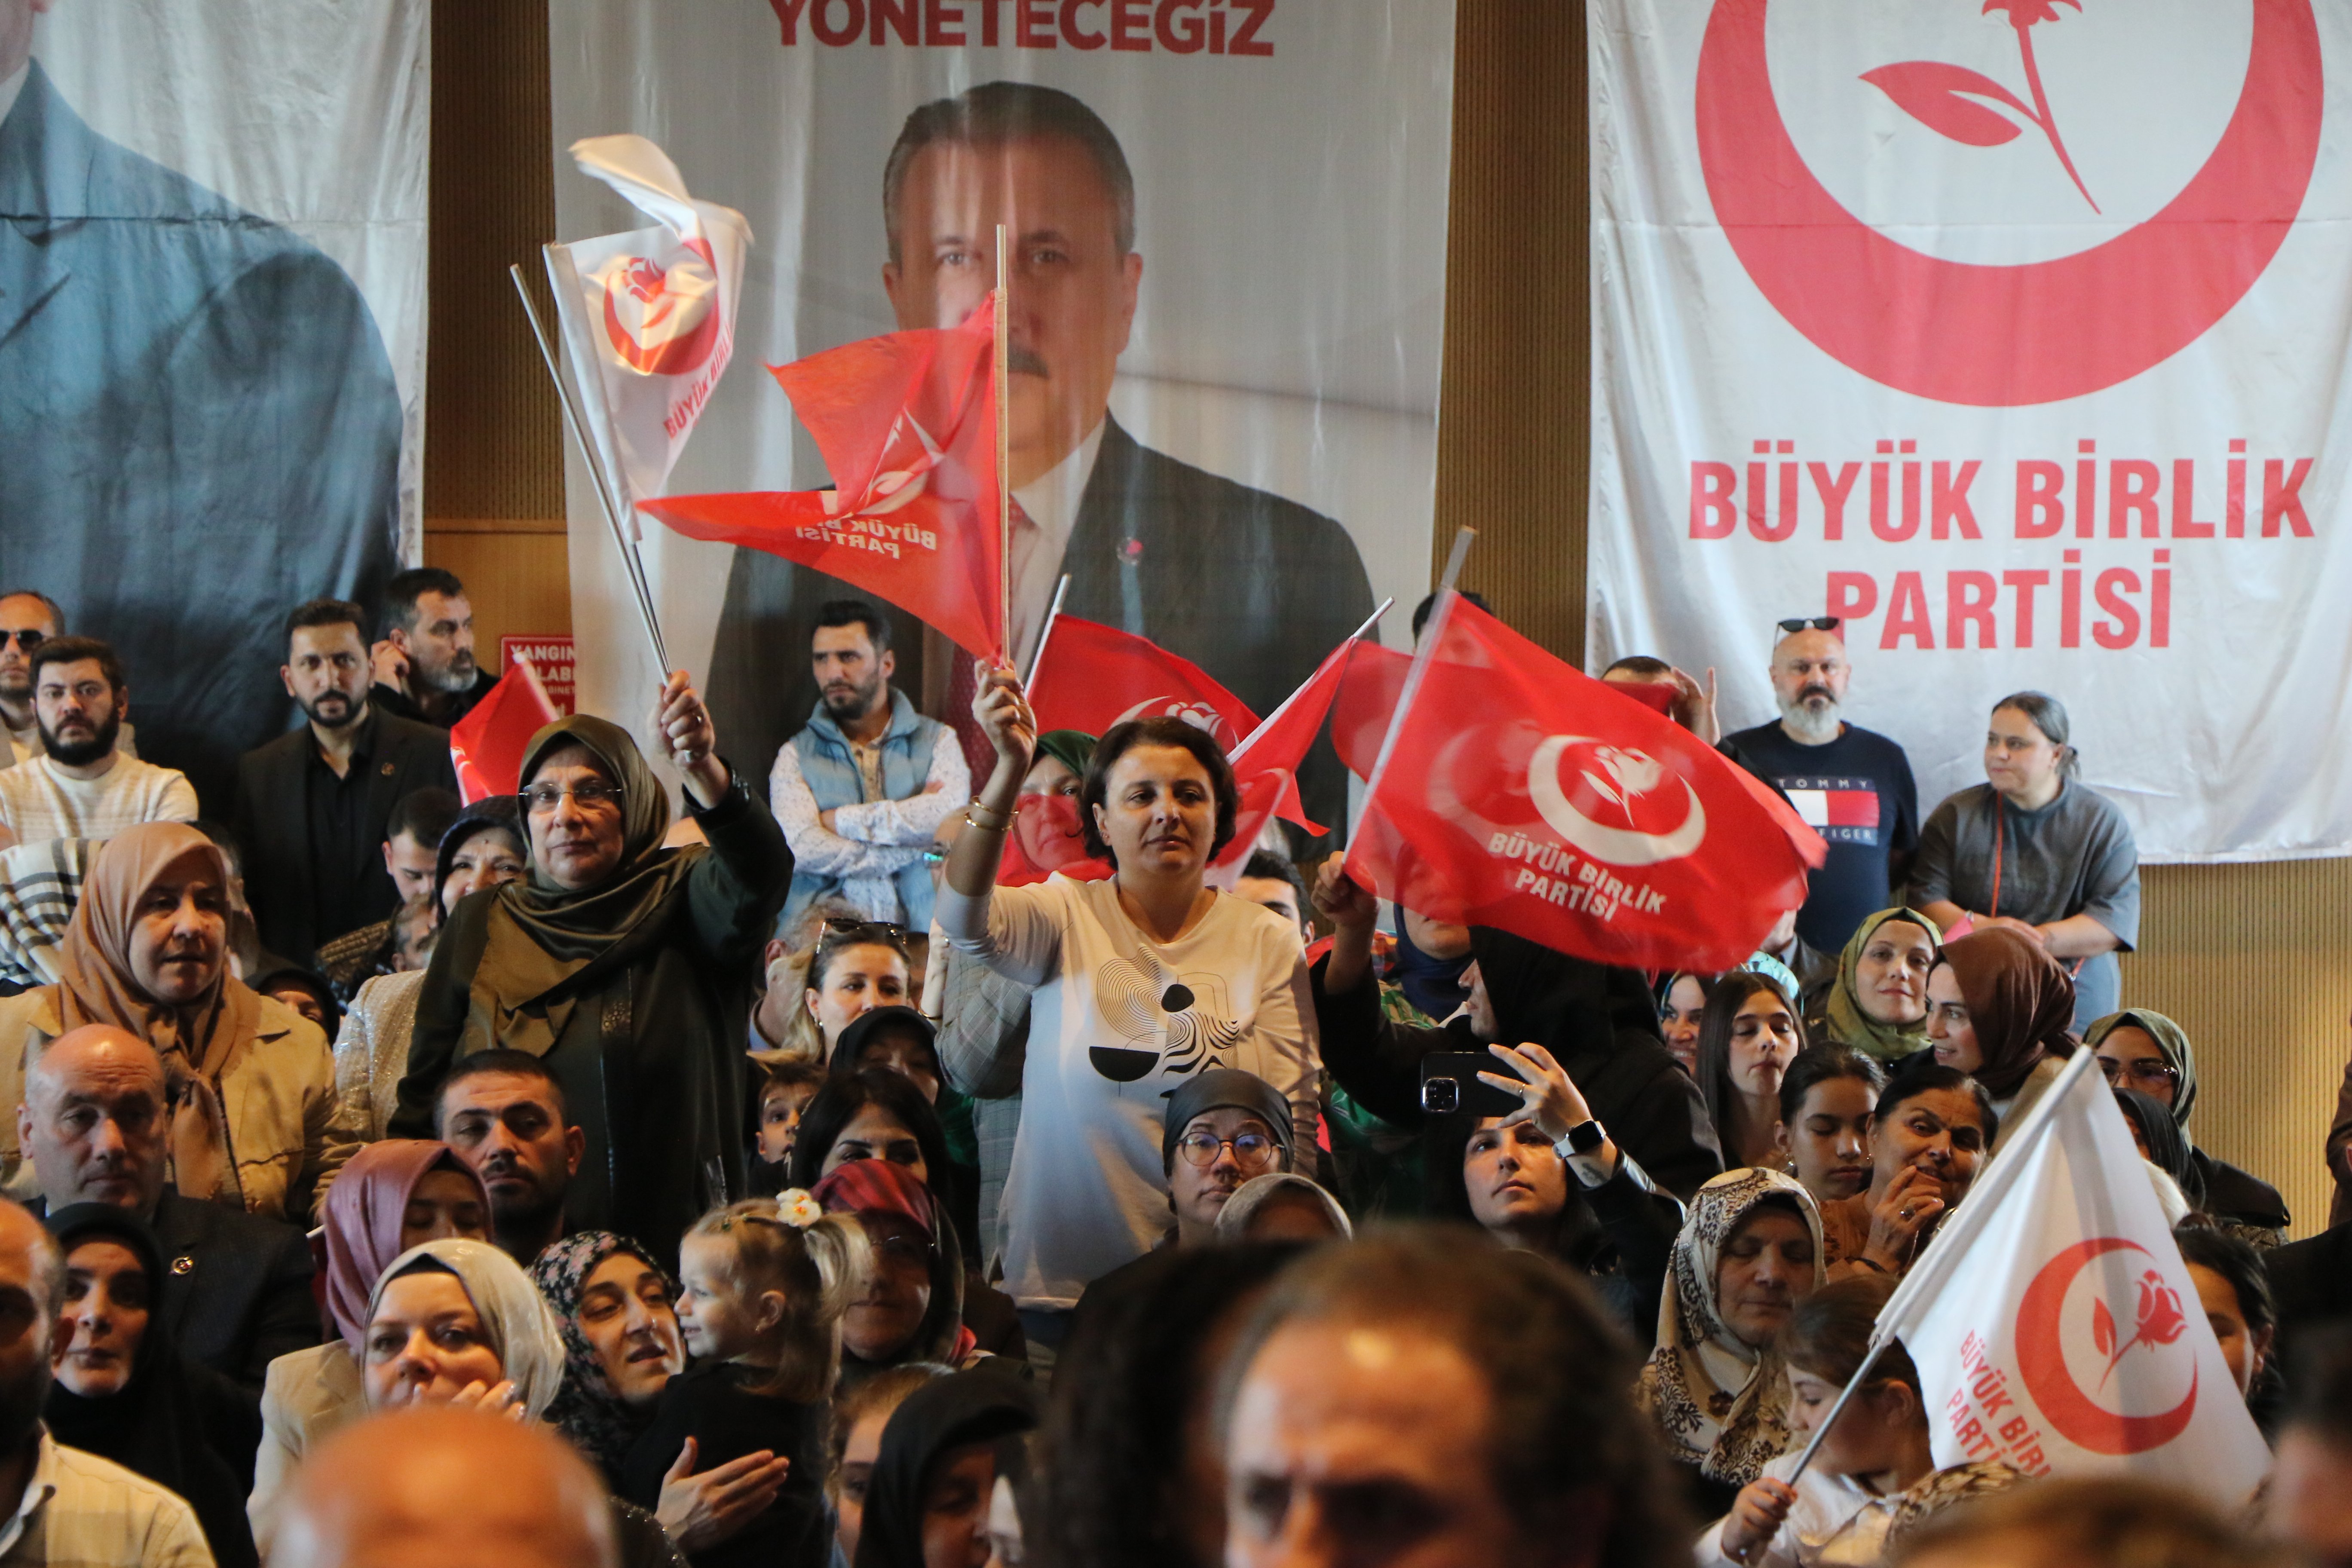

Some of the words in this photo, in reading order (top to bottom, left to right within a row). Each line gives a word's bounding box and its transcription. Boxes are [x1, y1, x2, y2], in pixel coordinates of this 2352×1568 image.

[1688, 439, 1983, 542] BÜYÜK
[2014, 438, 2315, 539] BİRLİK
[1825, 548, 2171, 650] PARTİSİ
[1779, 778, 1867, 789] TOMMY
[1487, 832, 1577, 876] BÜYÜK
[1578, 861, 1667, 915] BİRLİK
[1514, 868, 1620, 922] PARTİSİ
[1959, 1329, 2014, 1420] BÜYÜK
[1946, 1388, 2007, 1462] PARTİ
